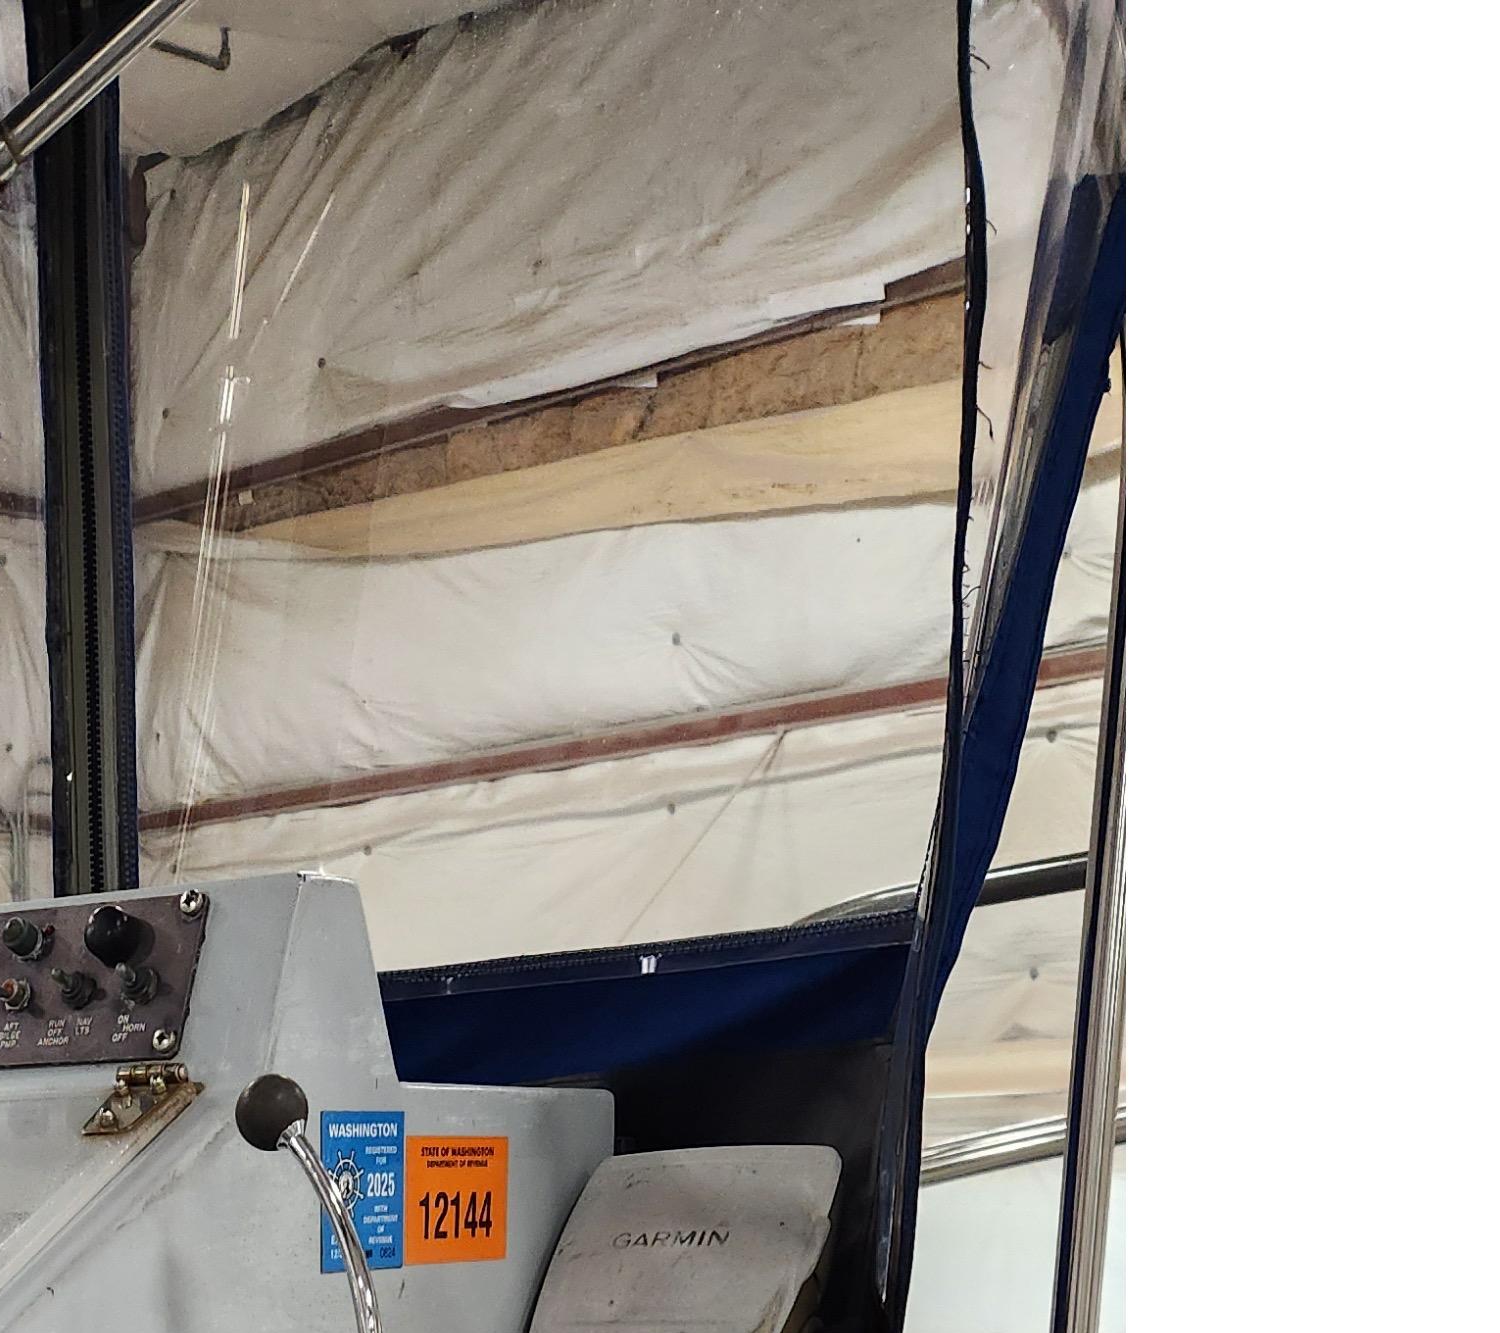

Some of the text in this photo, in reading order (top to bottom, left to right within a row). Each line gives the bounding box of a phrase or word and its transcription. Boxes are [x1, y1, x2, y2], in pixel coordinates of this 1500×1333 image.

[117, 1014, 130, 1025] ON
[4, 1022, 20, 1031] AFT
[122, 1023, 146, 1032] HORN
[37, 1036, 69, 1046] ANCHOR
[111, 1032, 128, 1042] OFF
[329, 1123, 398, 1138] WASHINGTON
[421, 1147, 495, 1157] STATE OF WASHINGTON
[426, 1160, 458, 1168] DEPARTMENT
[367, 1172, 395, 1197] 2025
[419, 1191, 493, 1239] 12144
[612, 1230, 730, 1249] GARMIN
